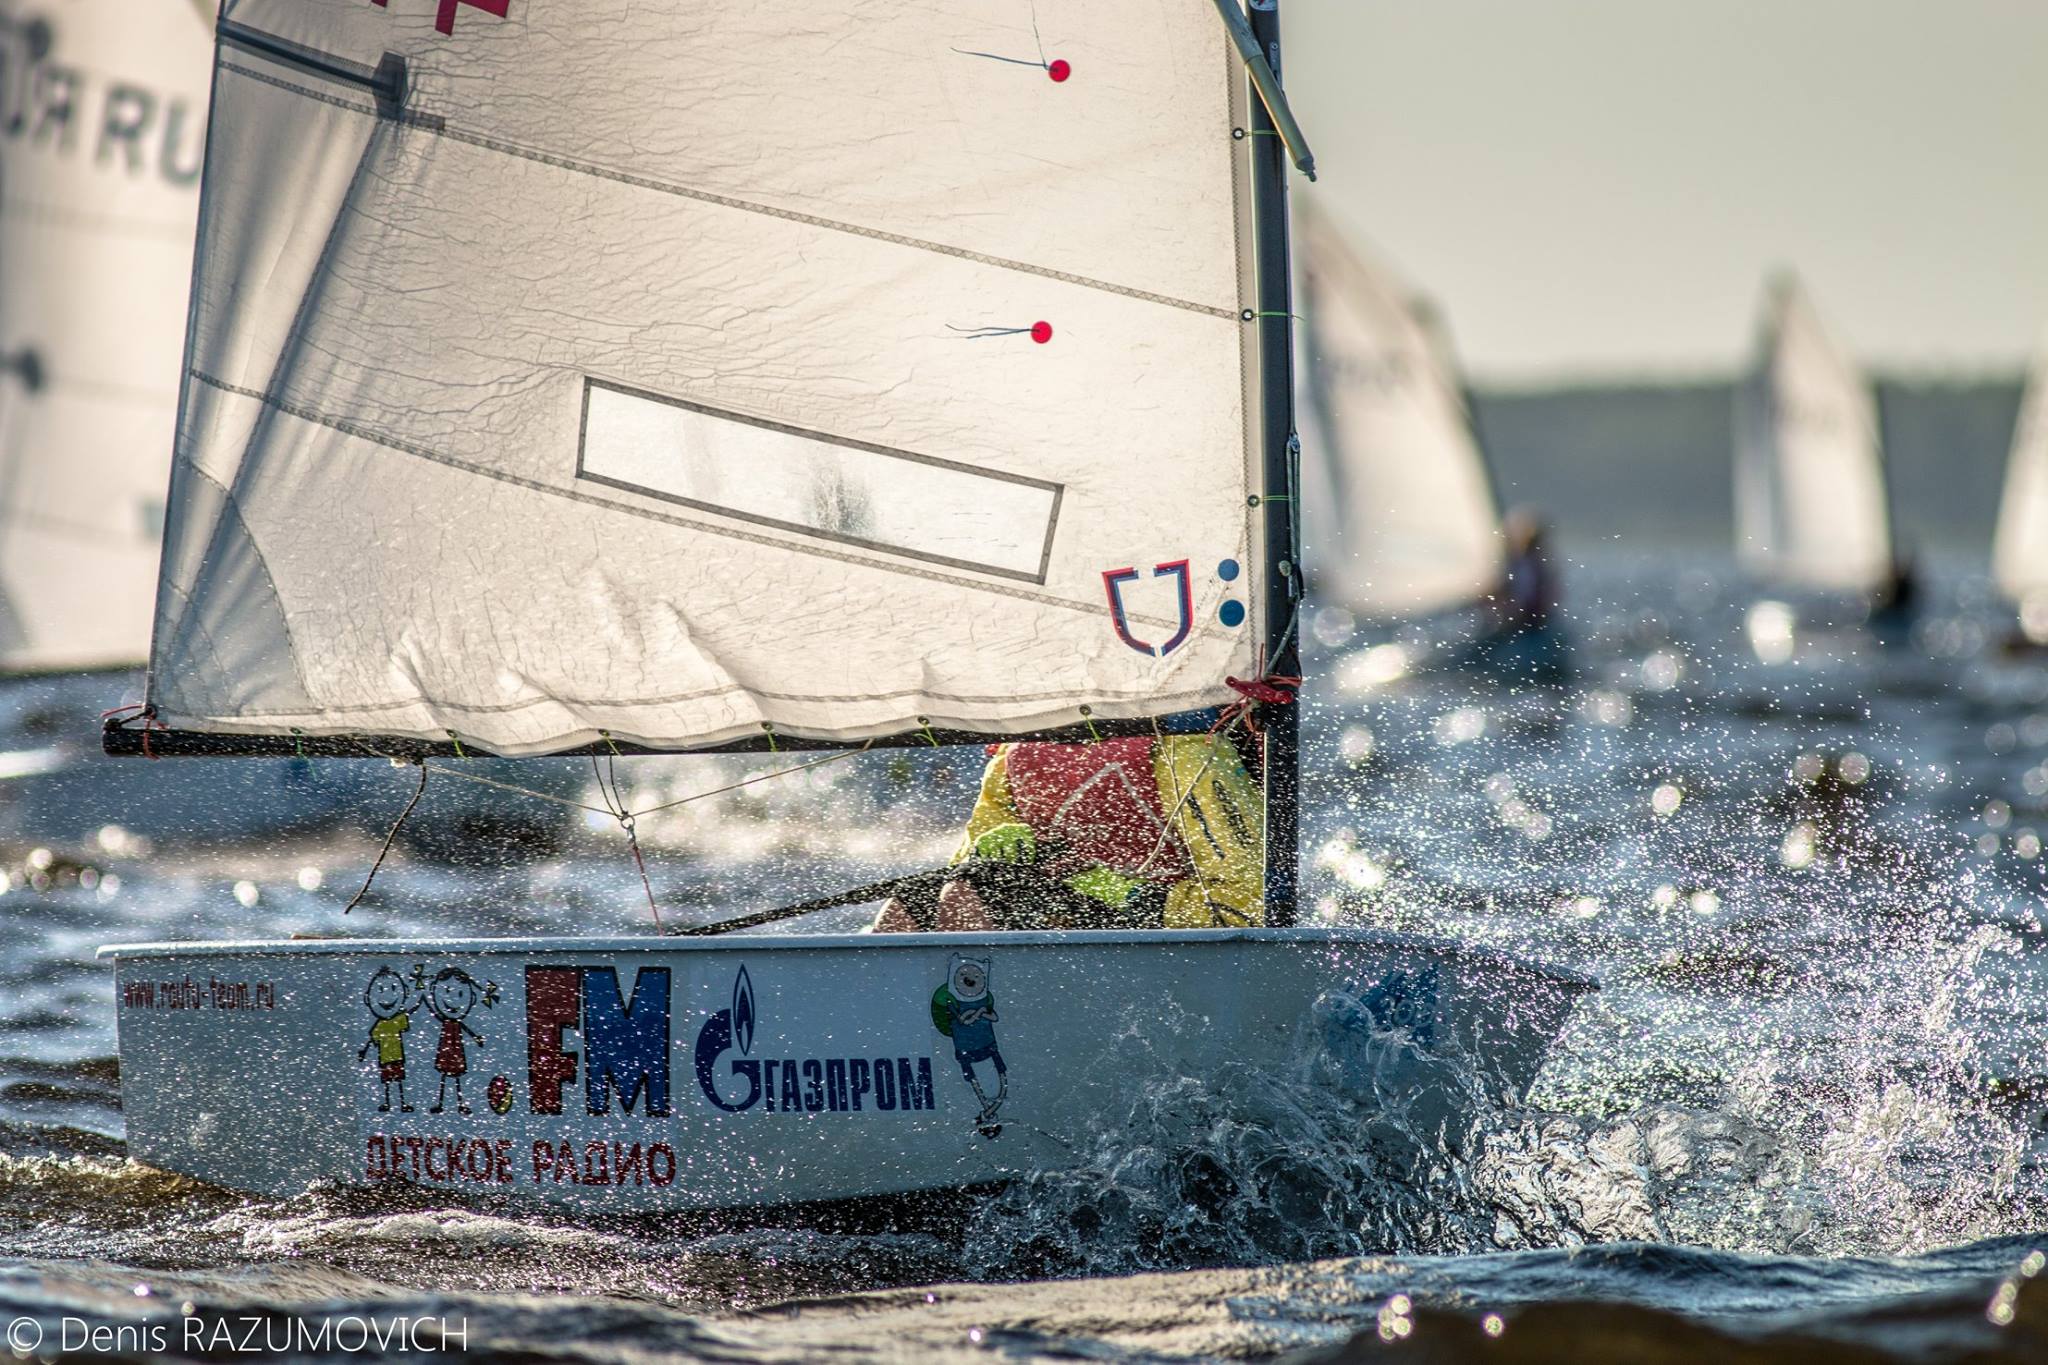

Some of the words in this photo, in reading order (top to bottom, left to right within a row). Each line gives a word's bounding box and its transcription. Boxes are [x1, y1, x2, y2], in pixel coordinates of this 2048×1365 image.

[763, 1056, 935, 1113] ГАЗПРОМ
[365, 1135, 514, 1184] ДЕТСКОЕ
[532, 1138, 677, 1187] РАДИО
